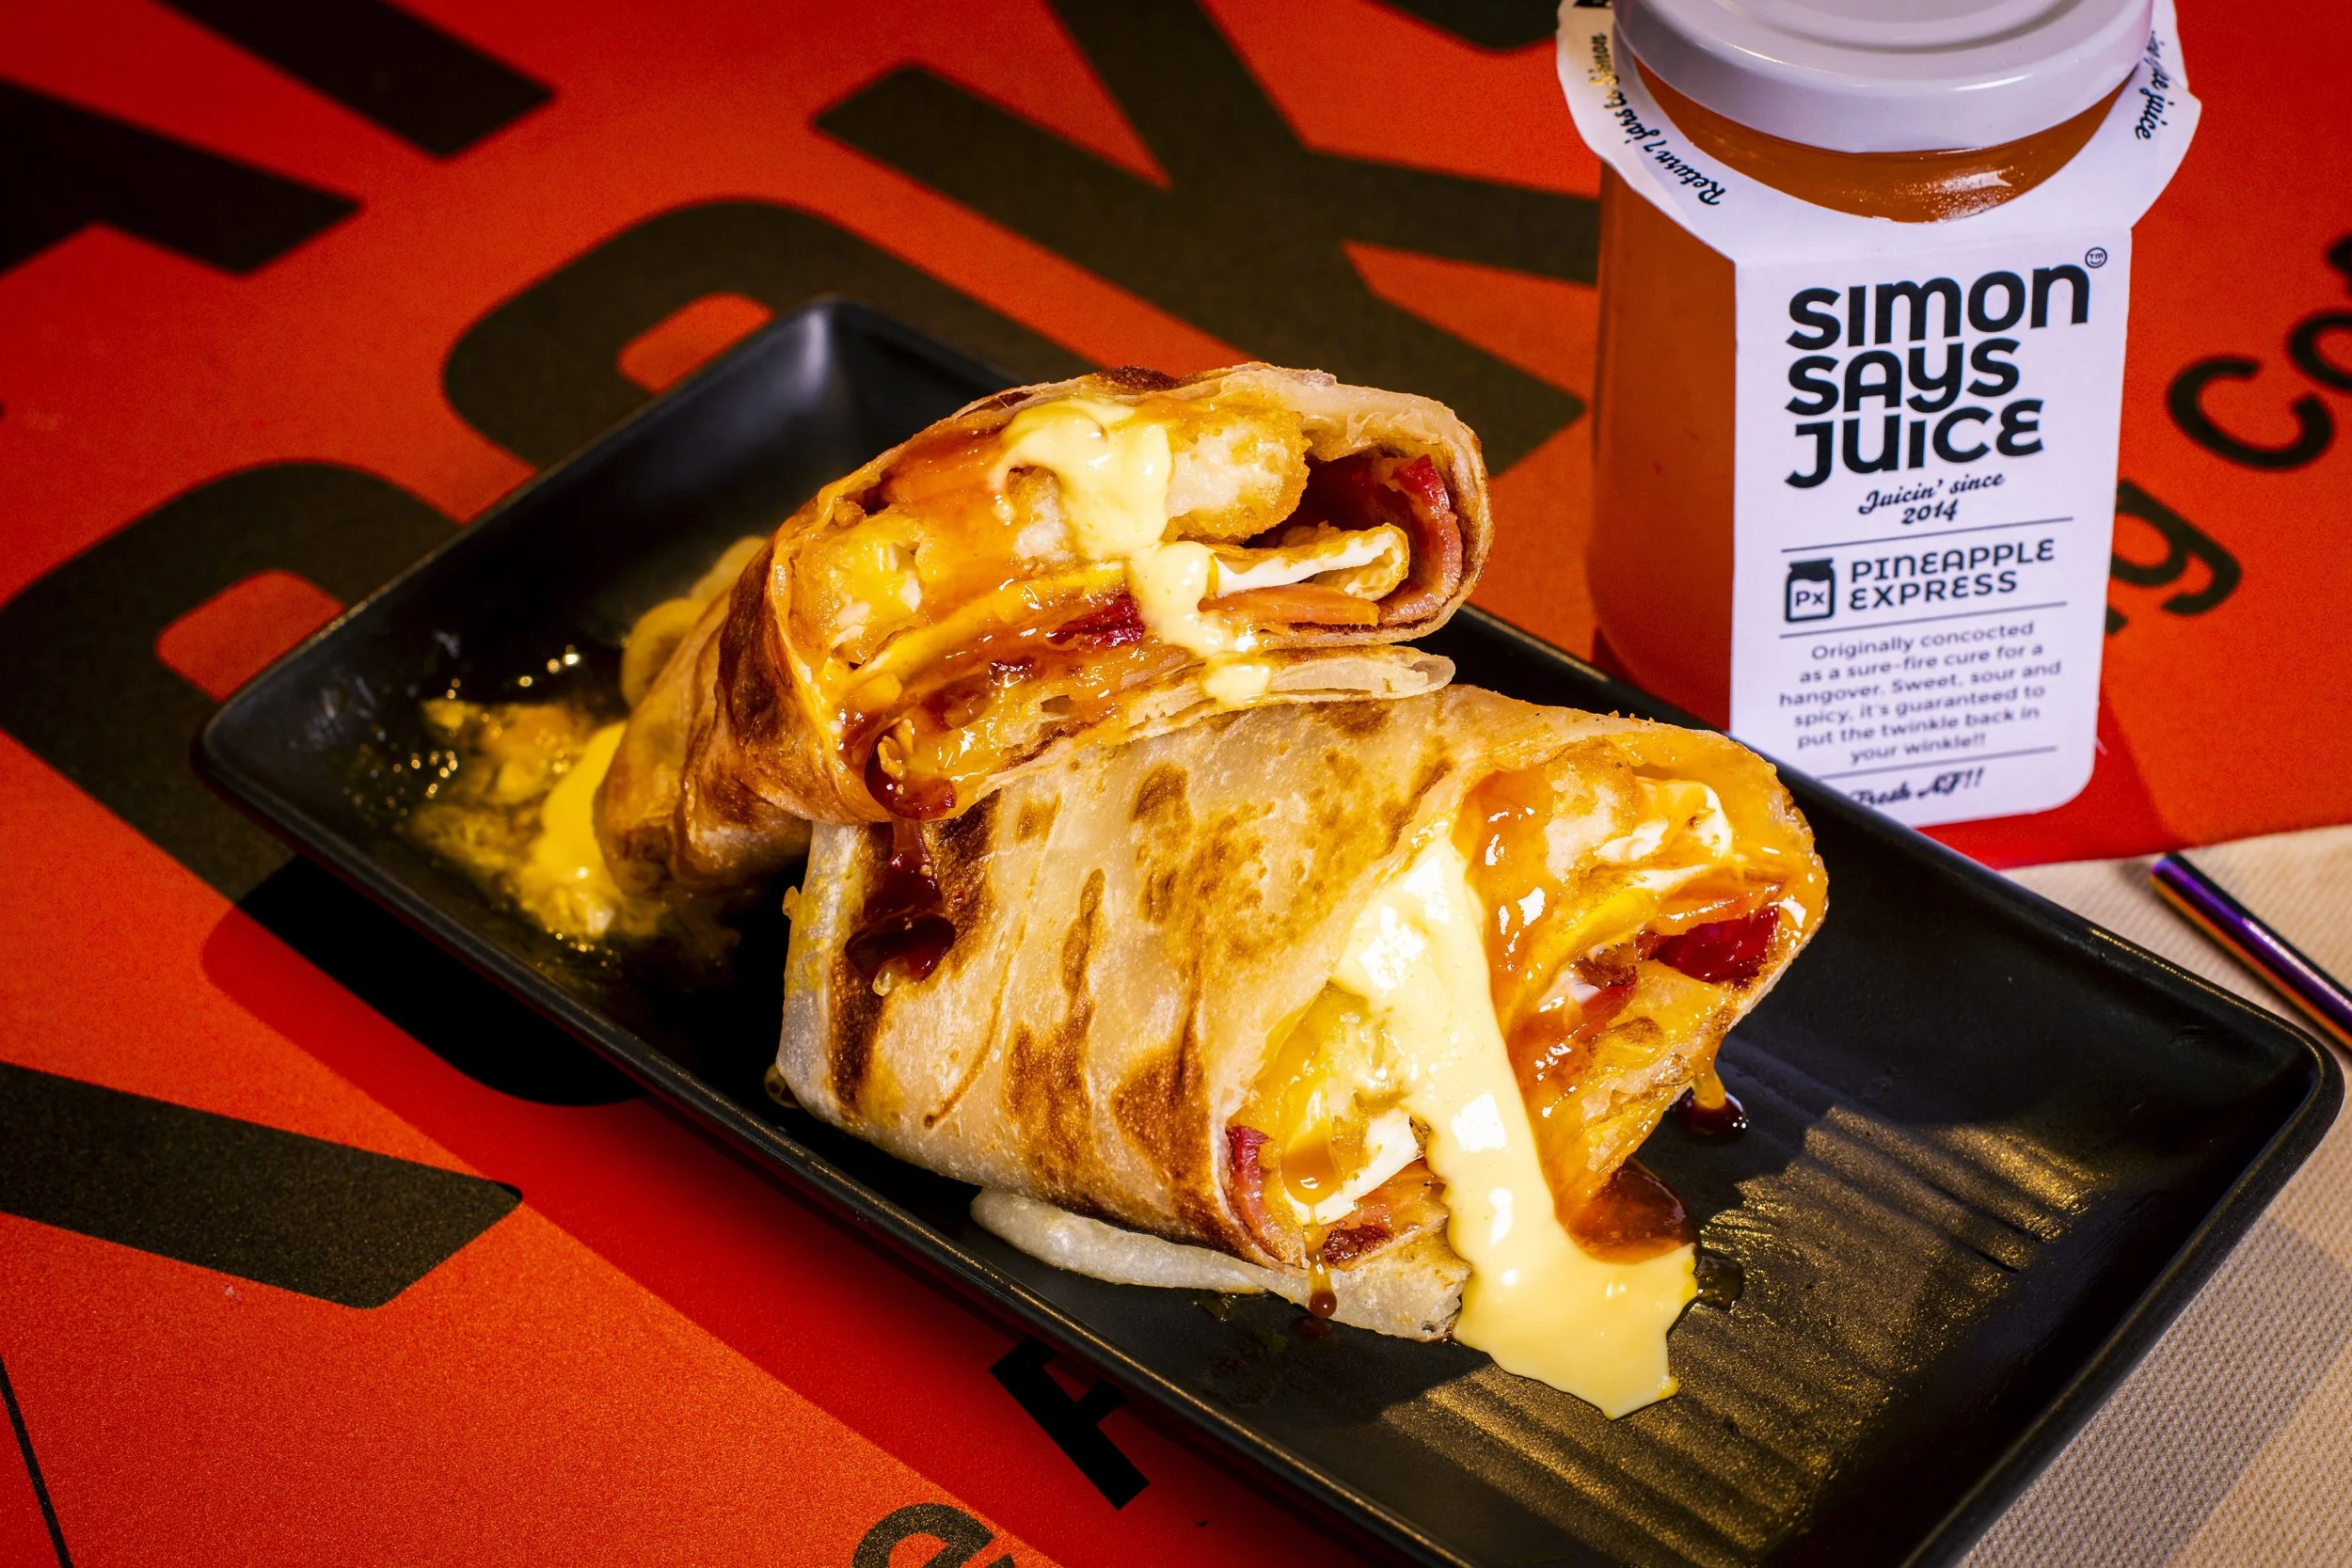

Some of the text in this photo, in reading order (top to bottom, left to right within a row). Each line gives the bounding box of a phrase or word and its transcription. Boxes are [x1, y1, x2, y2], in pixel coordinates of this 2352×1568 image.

[1614, 108, 1660, 144] jars
[2135, 87, 2174, 139] juice
[1655, 149, 1725, 206] Return
[1949, 472, 2005, 495] since
[1900, 499, 1959, 525] 2014
[1851, 538, 2055, 583] PINEAPPLE
[1795, 590, 1825, 607] Px
[1849, 570, 2018, 610] EXPRESS
[1811, 620, 2035, 660] Originally concocted
[1800, 643, 2043, 683] as a sure-fire cure for a
[1970, 668, 2015, 684] sour
[2022, 660, 2061, 678] and
[1896, 687, 2019, 716] guaranteed
[2024, 686, 2045, 698] to
[1798, 705, 2040, 750] put the twinkle back in
[1850, 746, 1897, 766] your
